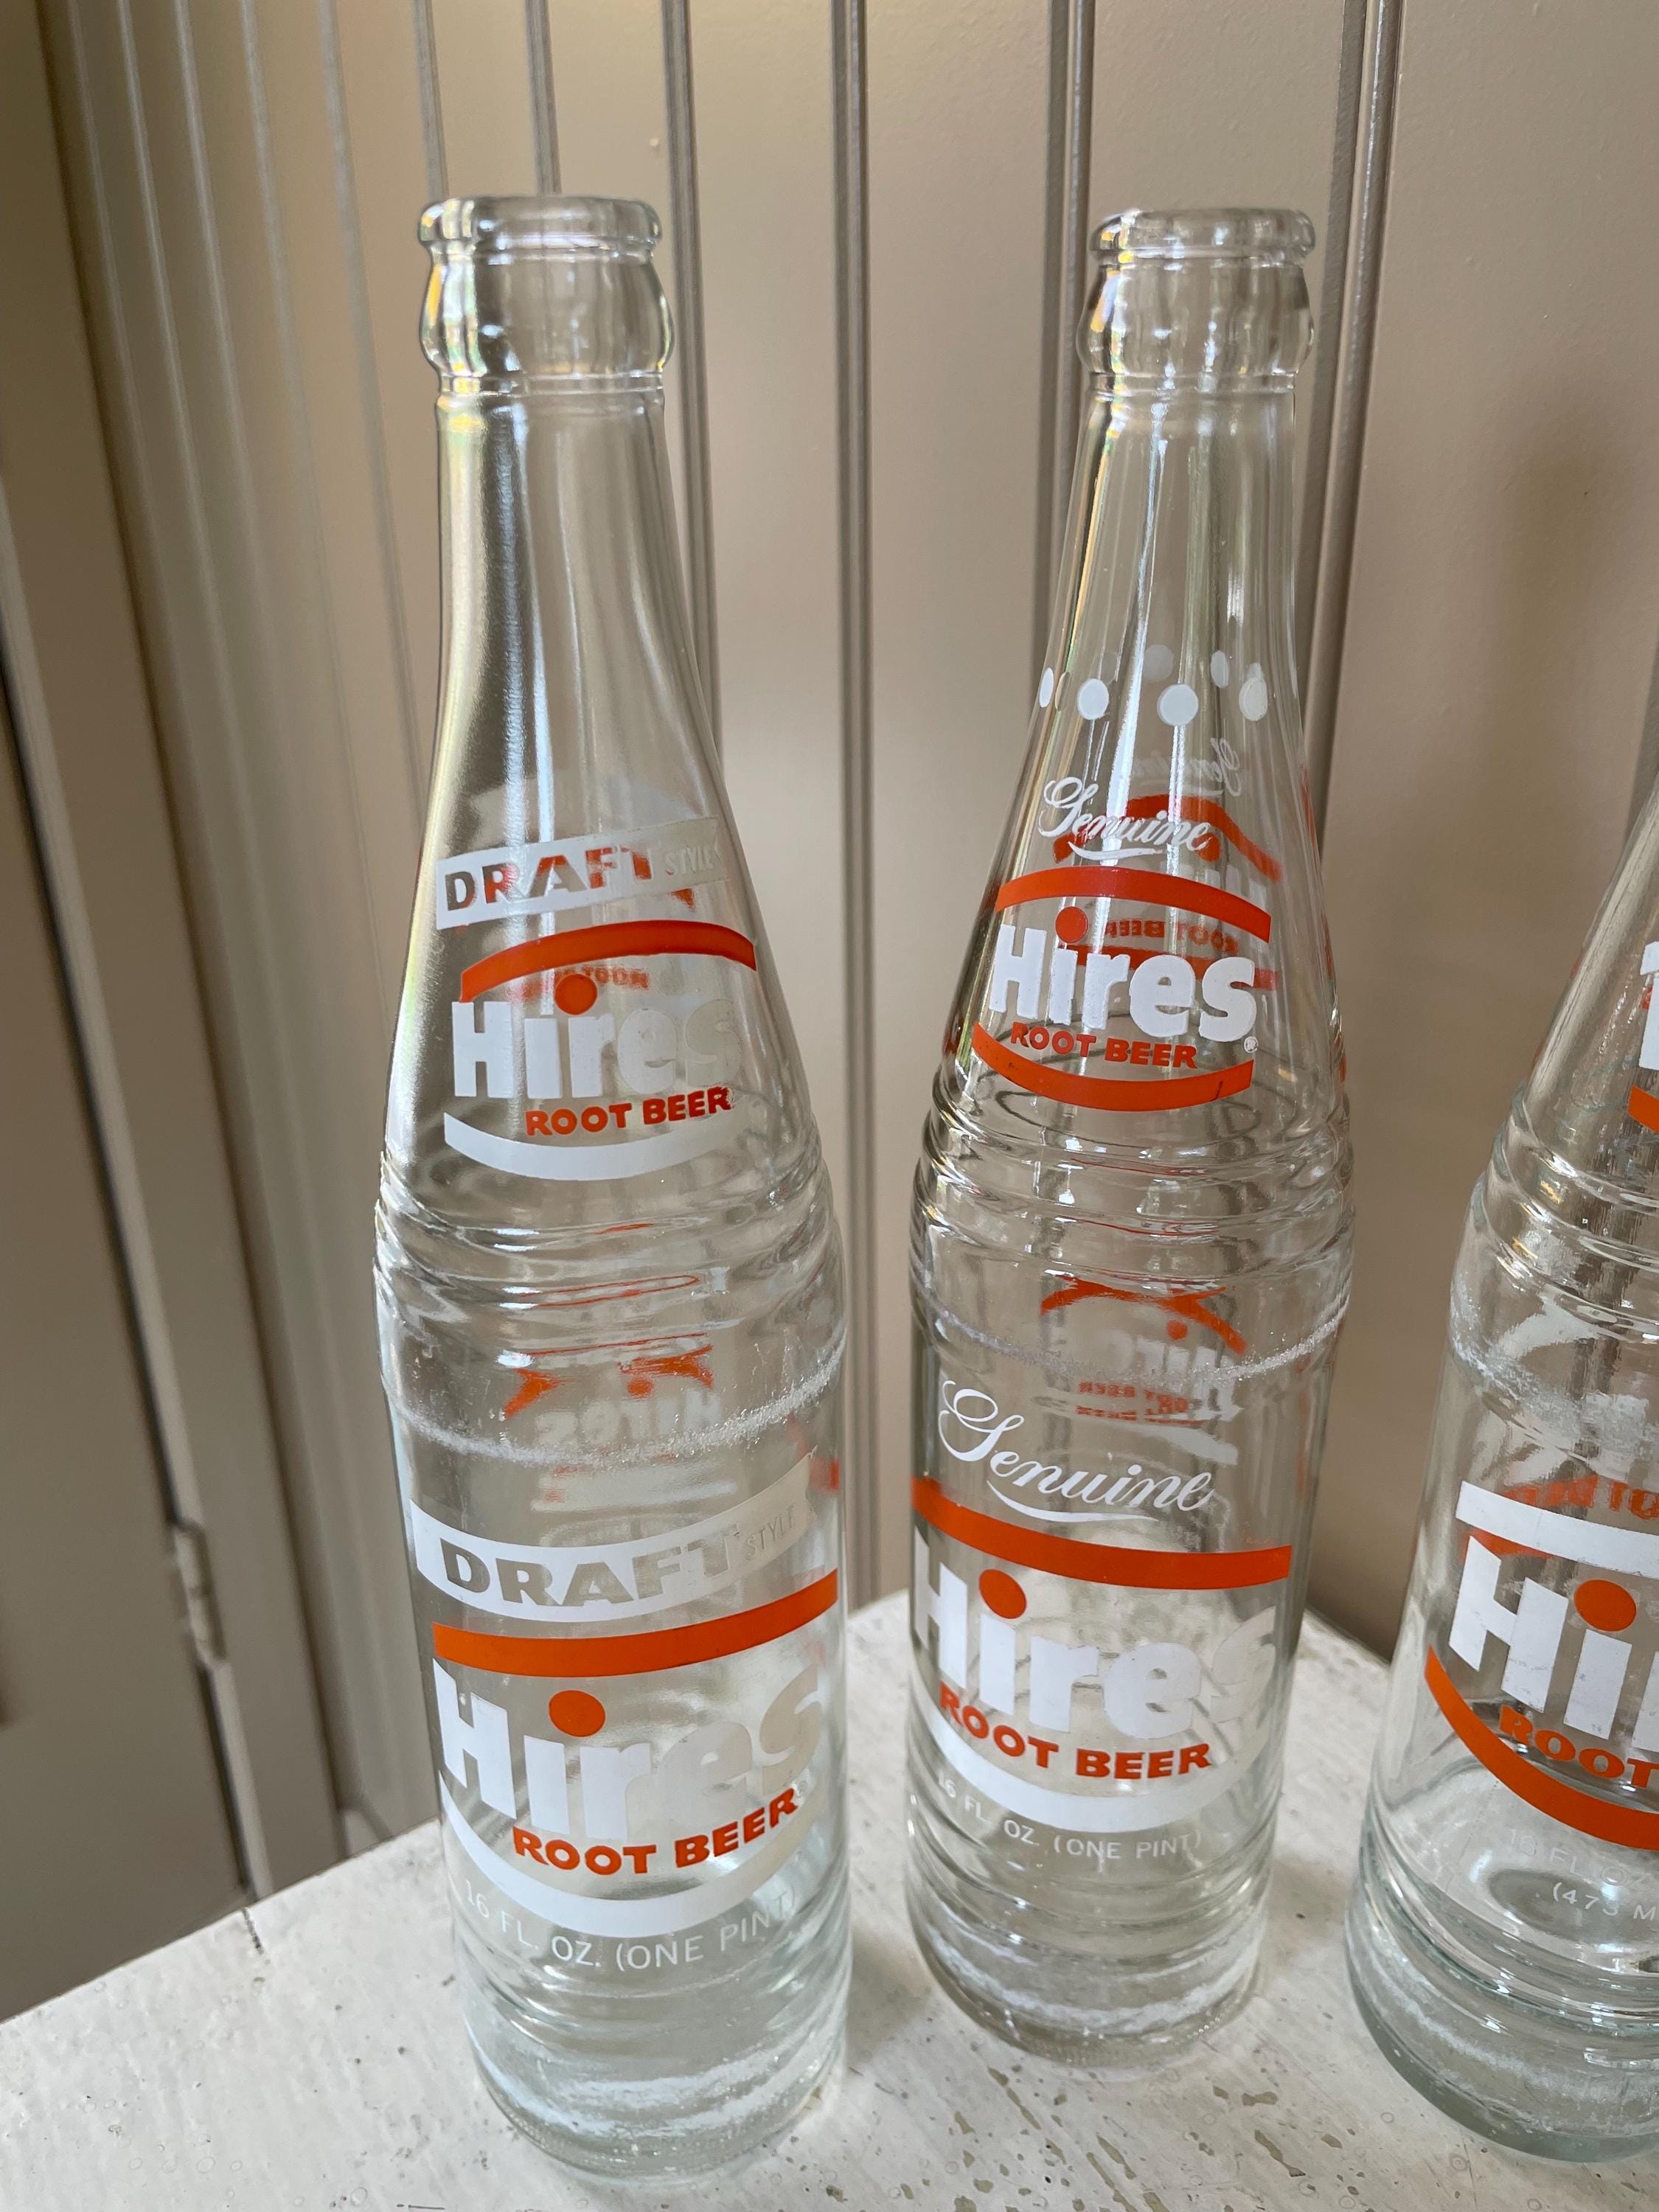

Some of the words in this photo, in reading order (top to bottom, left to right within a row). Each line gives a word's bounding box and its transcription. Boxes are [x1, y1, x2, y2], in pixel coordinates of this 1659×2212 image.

[1037, 776, 1212, 852] Genuine
[445, 846, 651, 911] DRAFT
[988, 906, 1256, 1043] Hires
[451, 974, 742, 1099] Hires
[1010, 1022, 1097, 1058] ROOT
[1106, 1040, 1197, 1069] BEER
[525, 1103, 633, 1135] ROOT
[643, 1085, 731, 1125] BEER
[938, 1380, 1215, 1513] Genuine
[440, 1525, 741, 1607] DRAFT
[745, 1504, 796, 1563] STYLE
[913, 1526, 1277, 1739] Hires
[433, 1658, 818, 1840] Hires
[939, 1680, 1059, 1769] ROOT
[1076, 1742, 1211, 1780] BEER
[1498, 1704, 1659, 1789] ROOT
[513, 1825, 656, 1876] ROOT
[675, 1787, 799, 1868] BEER
[1054, 1834, 1121, 1859] (ONE
[466, 1879, 490, 1919] 16
[552, 1935, 602, 1968] OZ.
[616, 1940, 703, 1972] (ONE
